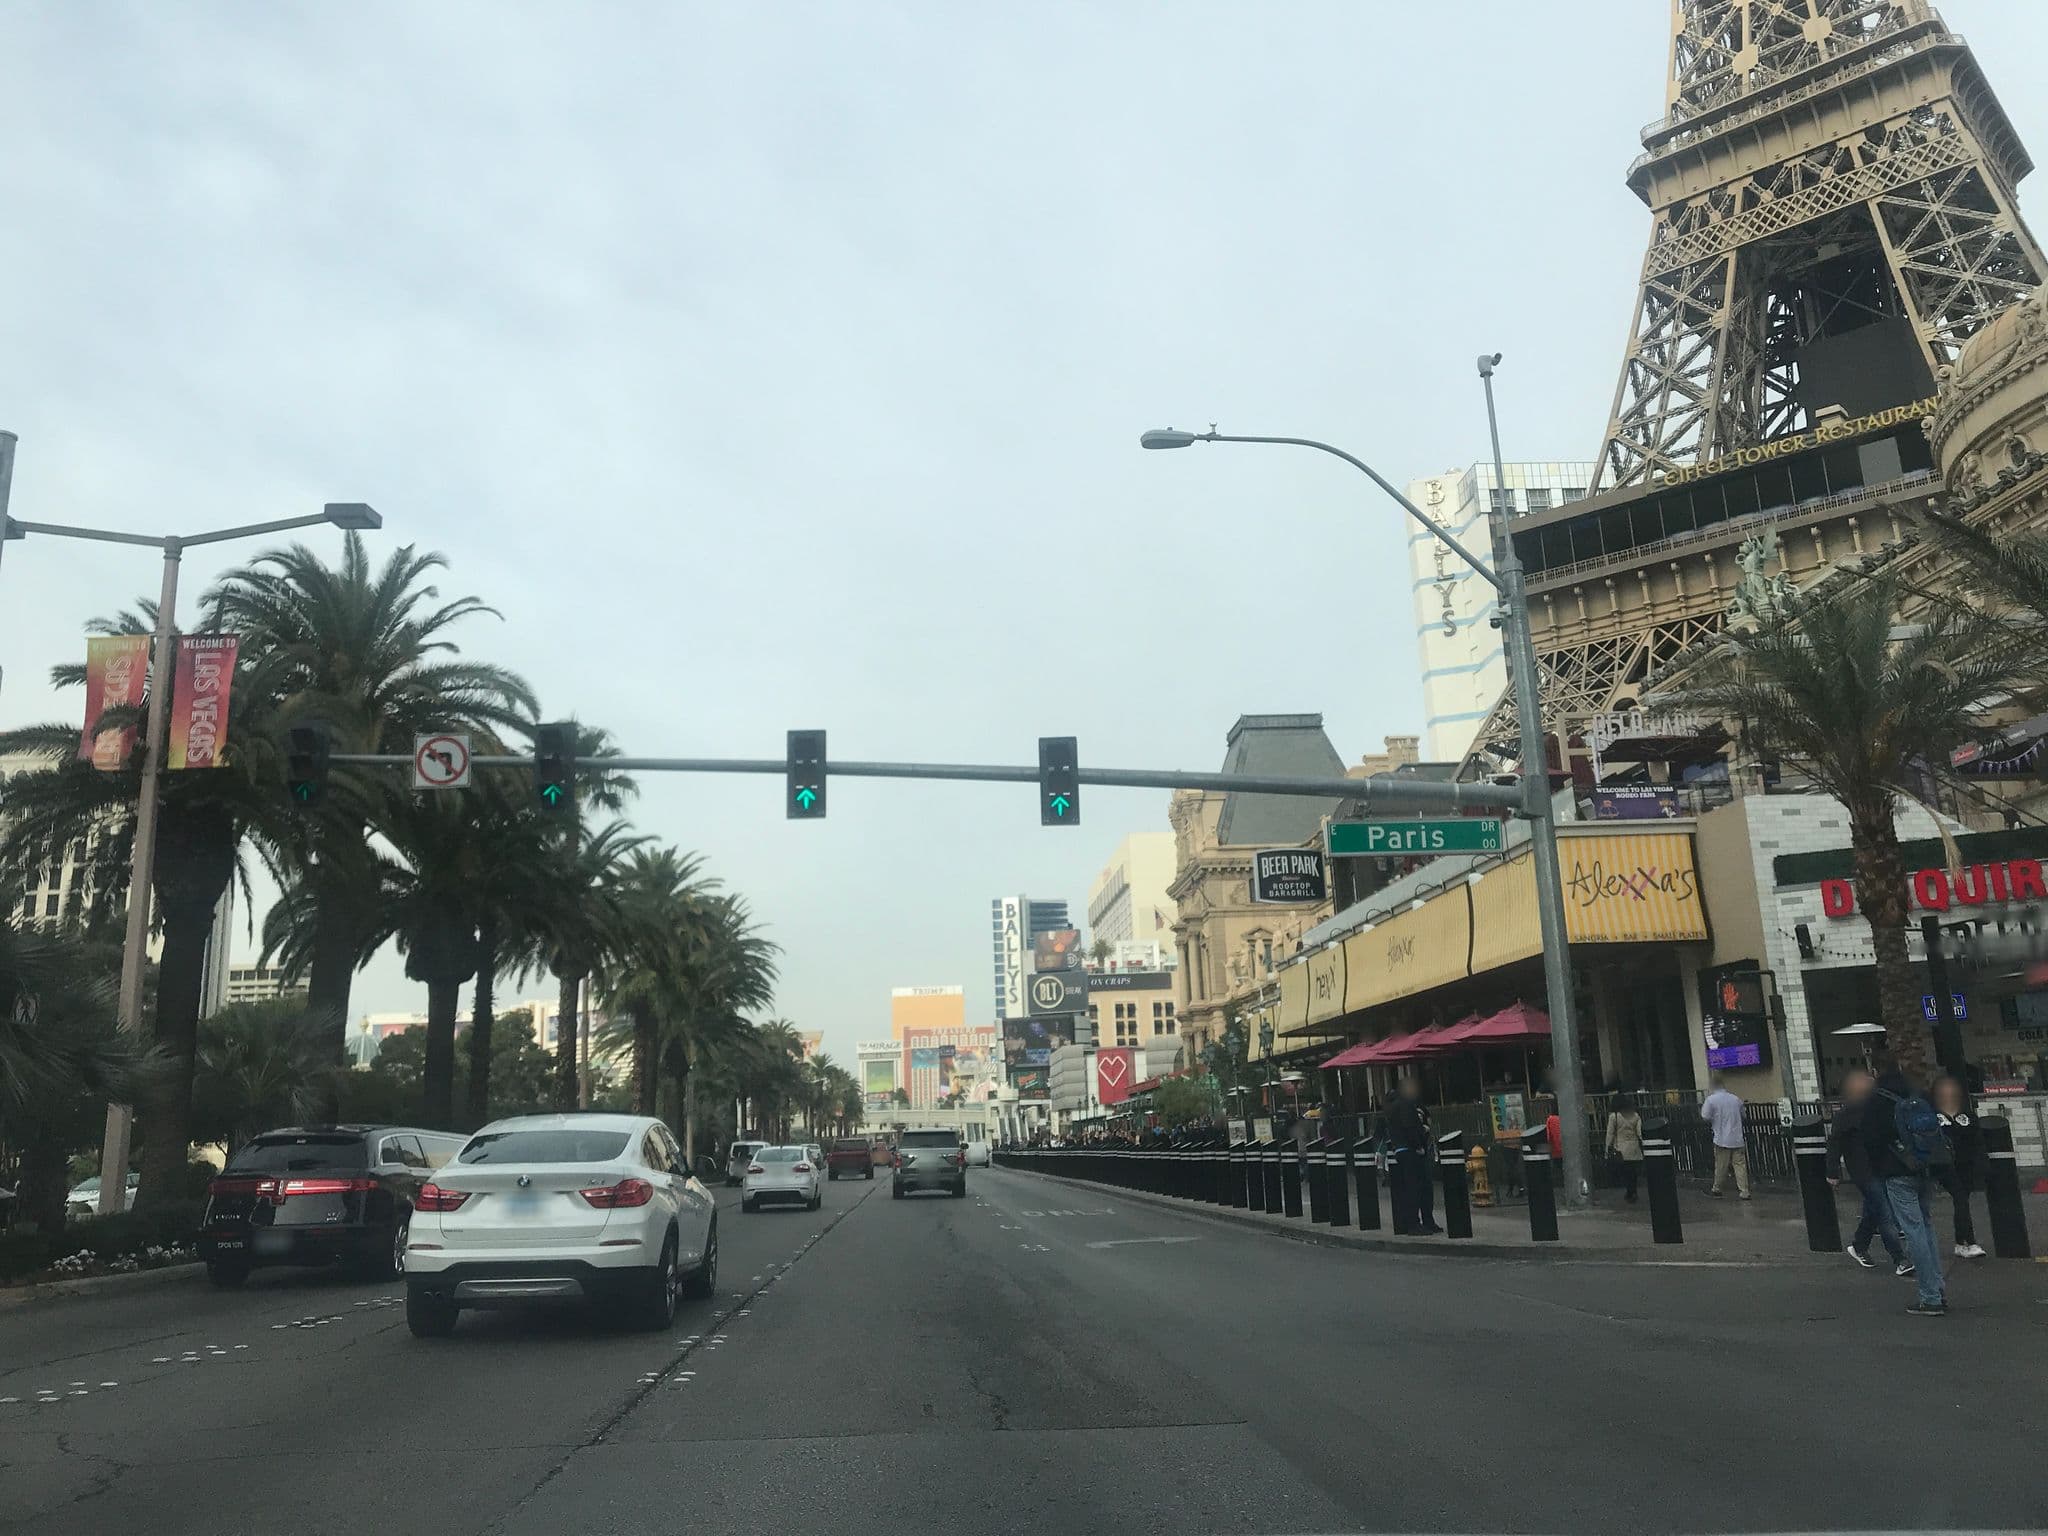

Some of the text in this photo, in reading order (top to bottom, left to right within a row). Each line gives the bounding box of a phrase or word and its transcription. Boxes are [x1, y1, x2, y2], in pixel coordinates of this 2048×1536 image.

[1664, 398, 1940, 486] EIFFEL TOWER RESTAURAN
[183, 637, 237, 650] WELCOME TO
[187, 652, 223, 763] LAS VEGAS
[1592, 711, 1644, 740] BEER
[1331, 821, 1496, 850] E Paris DR
[1482, 838, 1497, 849] 00
[1261, 855, 1320, 879] BEER PARK
[1272, 882, 1311, 890] ROOFTOP
[1820, 859, 2048, 918] DQUIR
[912, 987, 944, 996] TRUMP
[1039, 982, 1058, 1001] BLT
[1105, 977, 1131, 986] CRAPS
